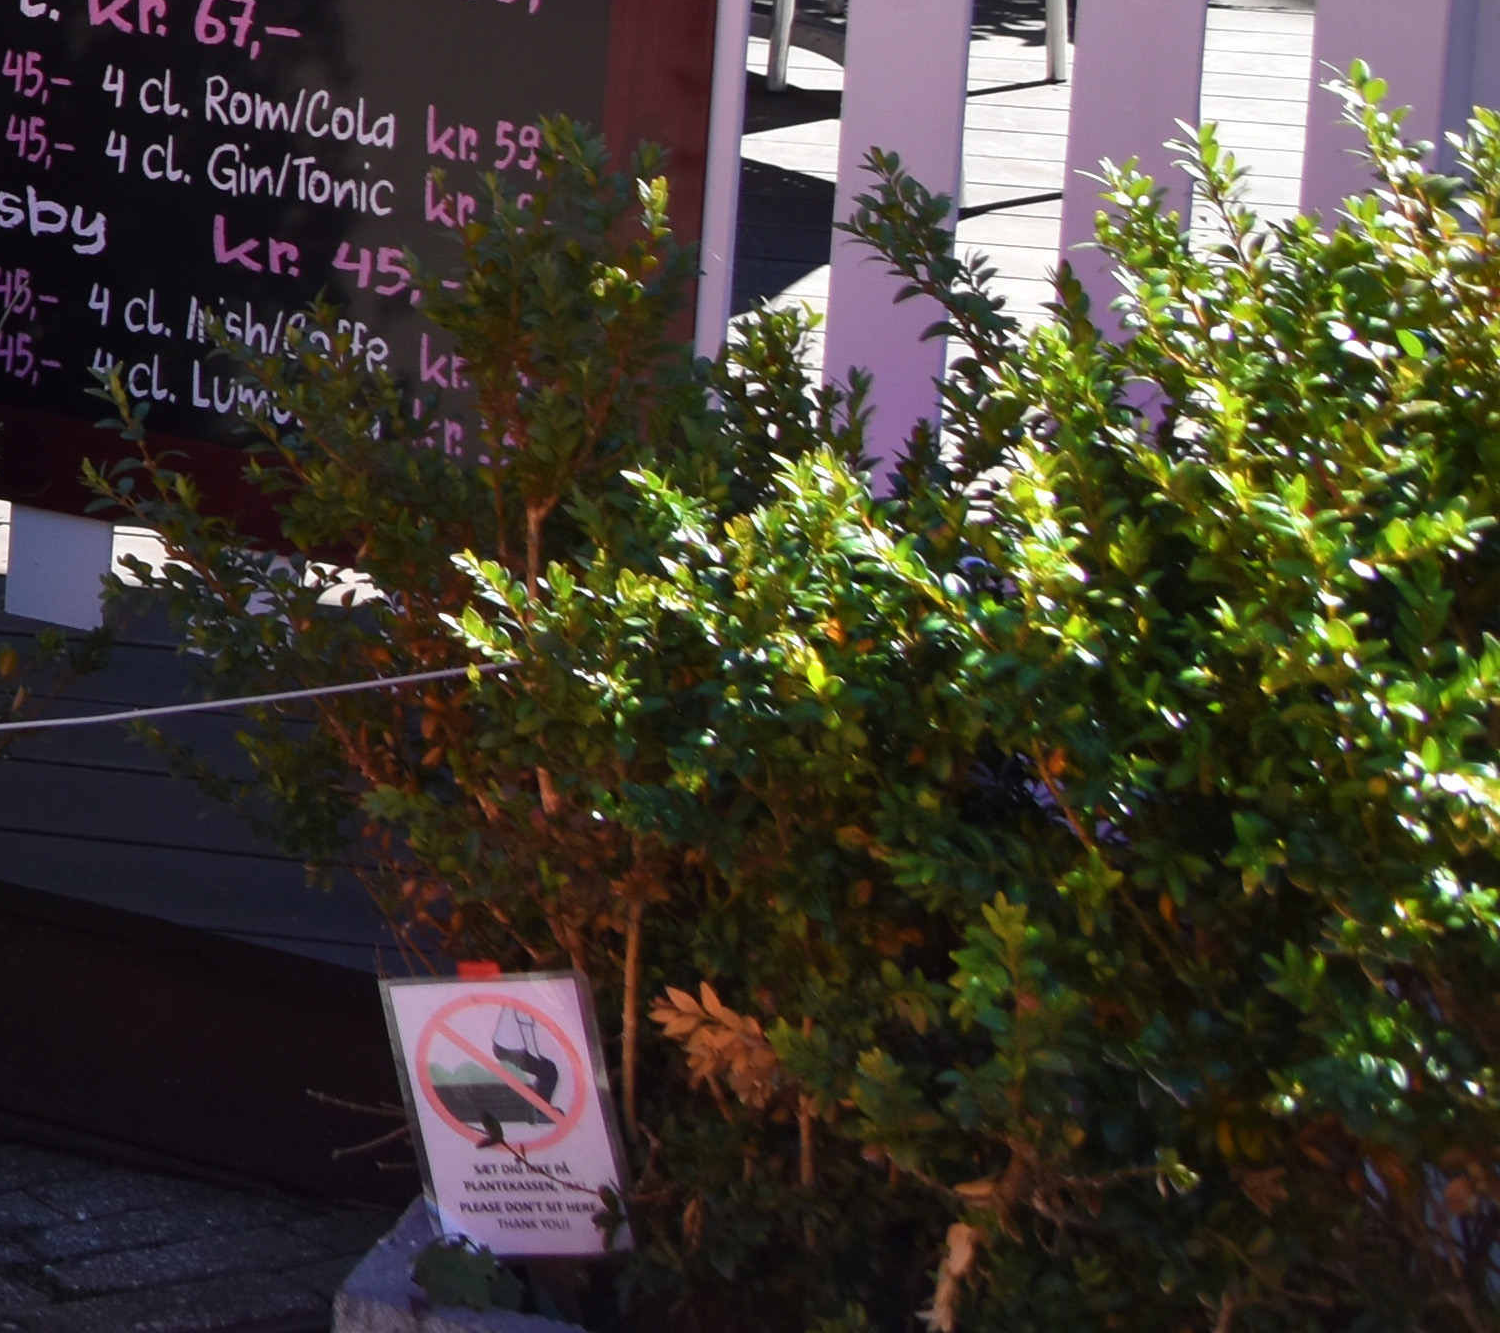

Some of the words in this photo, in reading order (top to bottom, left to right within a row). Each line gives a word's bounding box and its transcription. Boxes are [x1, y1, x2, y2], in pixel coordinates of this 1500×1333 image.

[2, 49, 72, 105] 45,-
[102, 64, 125, 109] 4
[139, 69, 189, 118] cl.
[205, 74, 396, 150] Rom/Cola
[427, 104, 478, 162] kr.
[6, 114, 76, 170] 45,-
[105, 130, 127, 174] 4
[142, 135, 192, 184] cl.
[207, 143, 395, 216] Gin/Tonic
[213, 214, 301, 277] kr.
[332, 240, 462, 305] 45,-
[88, 282, 110, 326] 4
[124, 288, 172, 337] cl.
[127, 353, 177, 403] cl.
[473, 1164, 498, 1175] SÆT
[460, 1202, 502, 1213] PLEASE
[505, 1202, 542, 1213] DON'T
[545, 1202, 562, 1212] SIT
[498, 1218, 537, 1230] THANK
